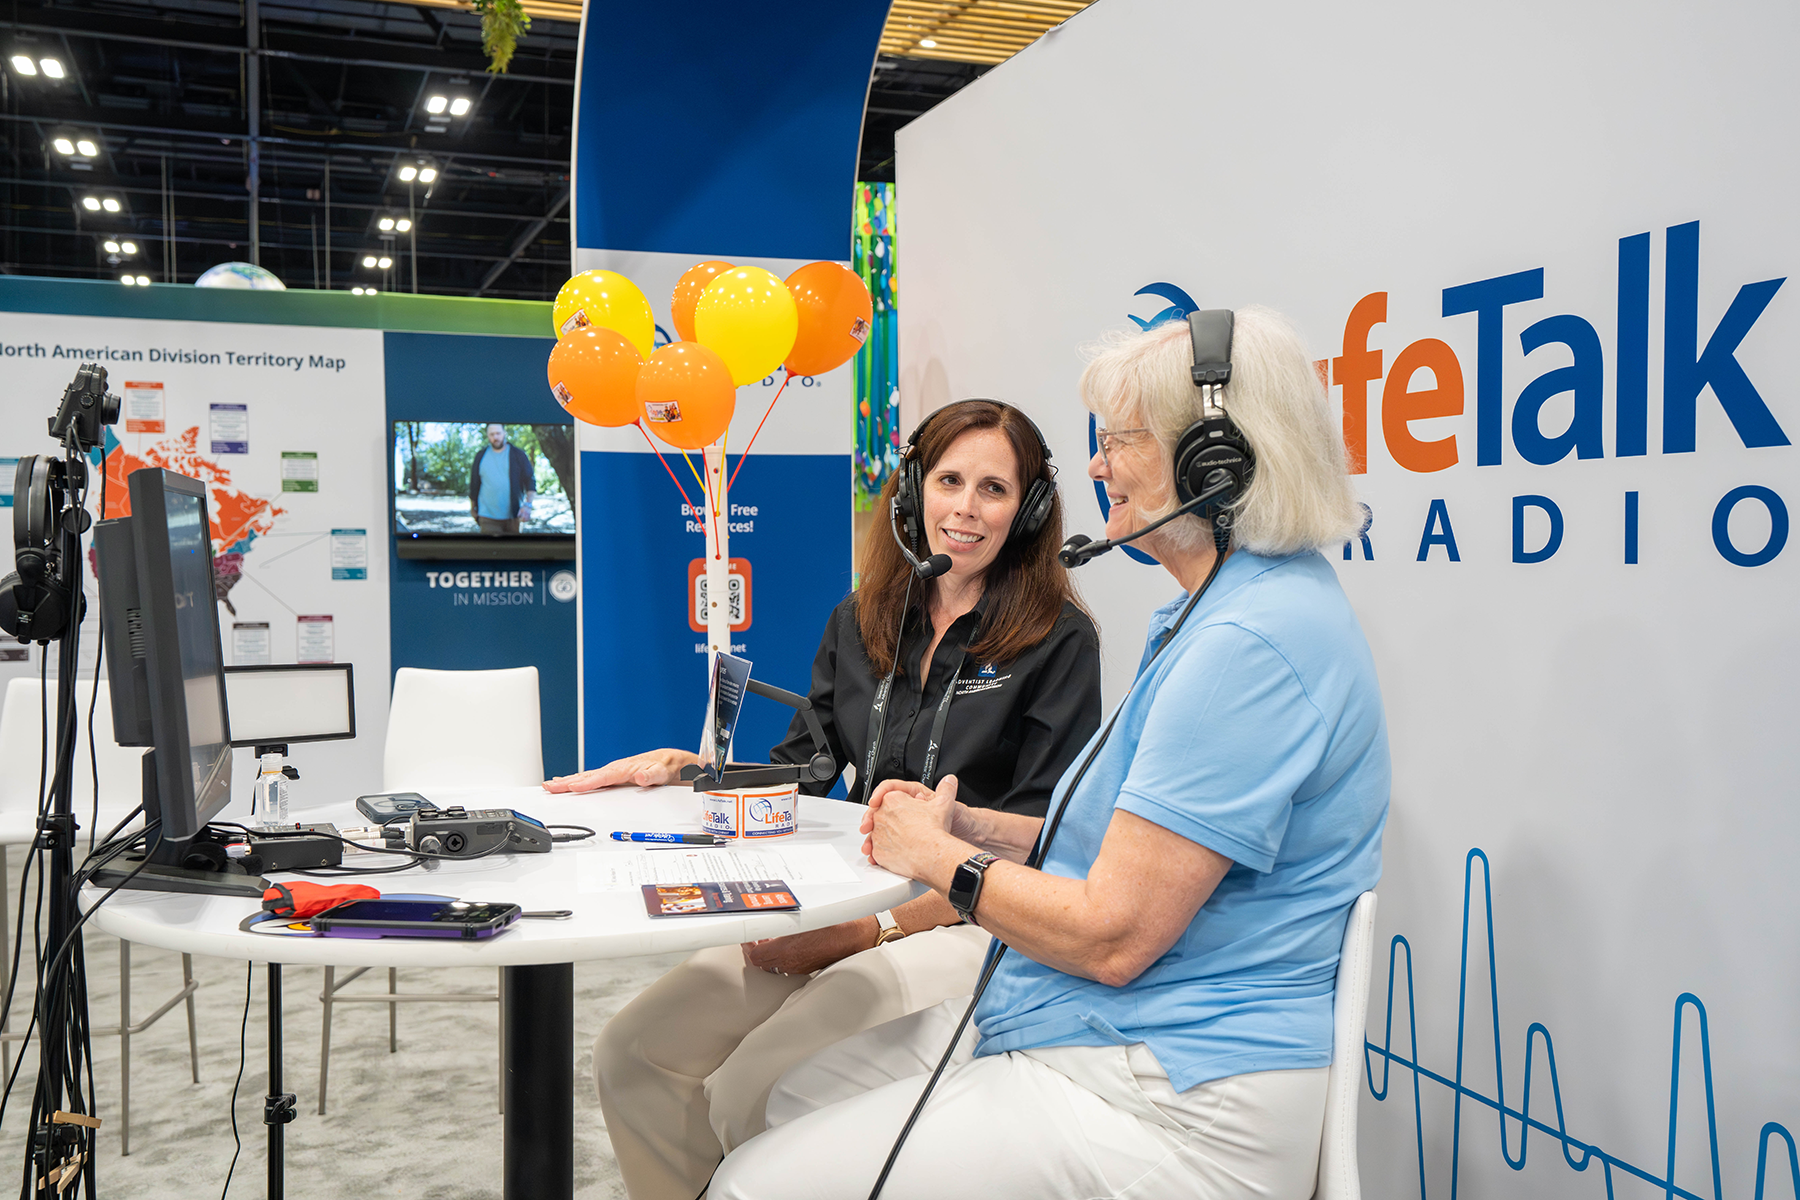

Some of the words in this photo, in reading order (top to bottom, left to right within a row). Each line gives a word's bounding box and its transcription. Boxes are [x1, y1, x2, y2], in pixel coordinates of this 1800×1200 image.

[1313, 220, 1792, 476] feTalk
[52, 344, 143, 361] American
[149, 348, 220, 365] Division
[225, 351, 303, 371] Territory
[309, 355, 346, 372] Map
[1201, 457, 1242, 467] audio-technica
[731, 504, 758, 516] Free
[686, 520, 754, 532] Resces!
[426, 571, 534, 588] TOGETHER
[453, 592, 468, 606] IN
[473, 591, 533, 606] MISSION
